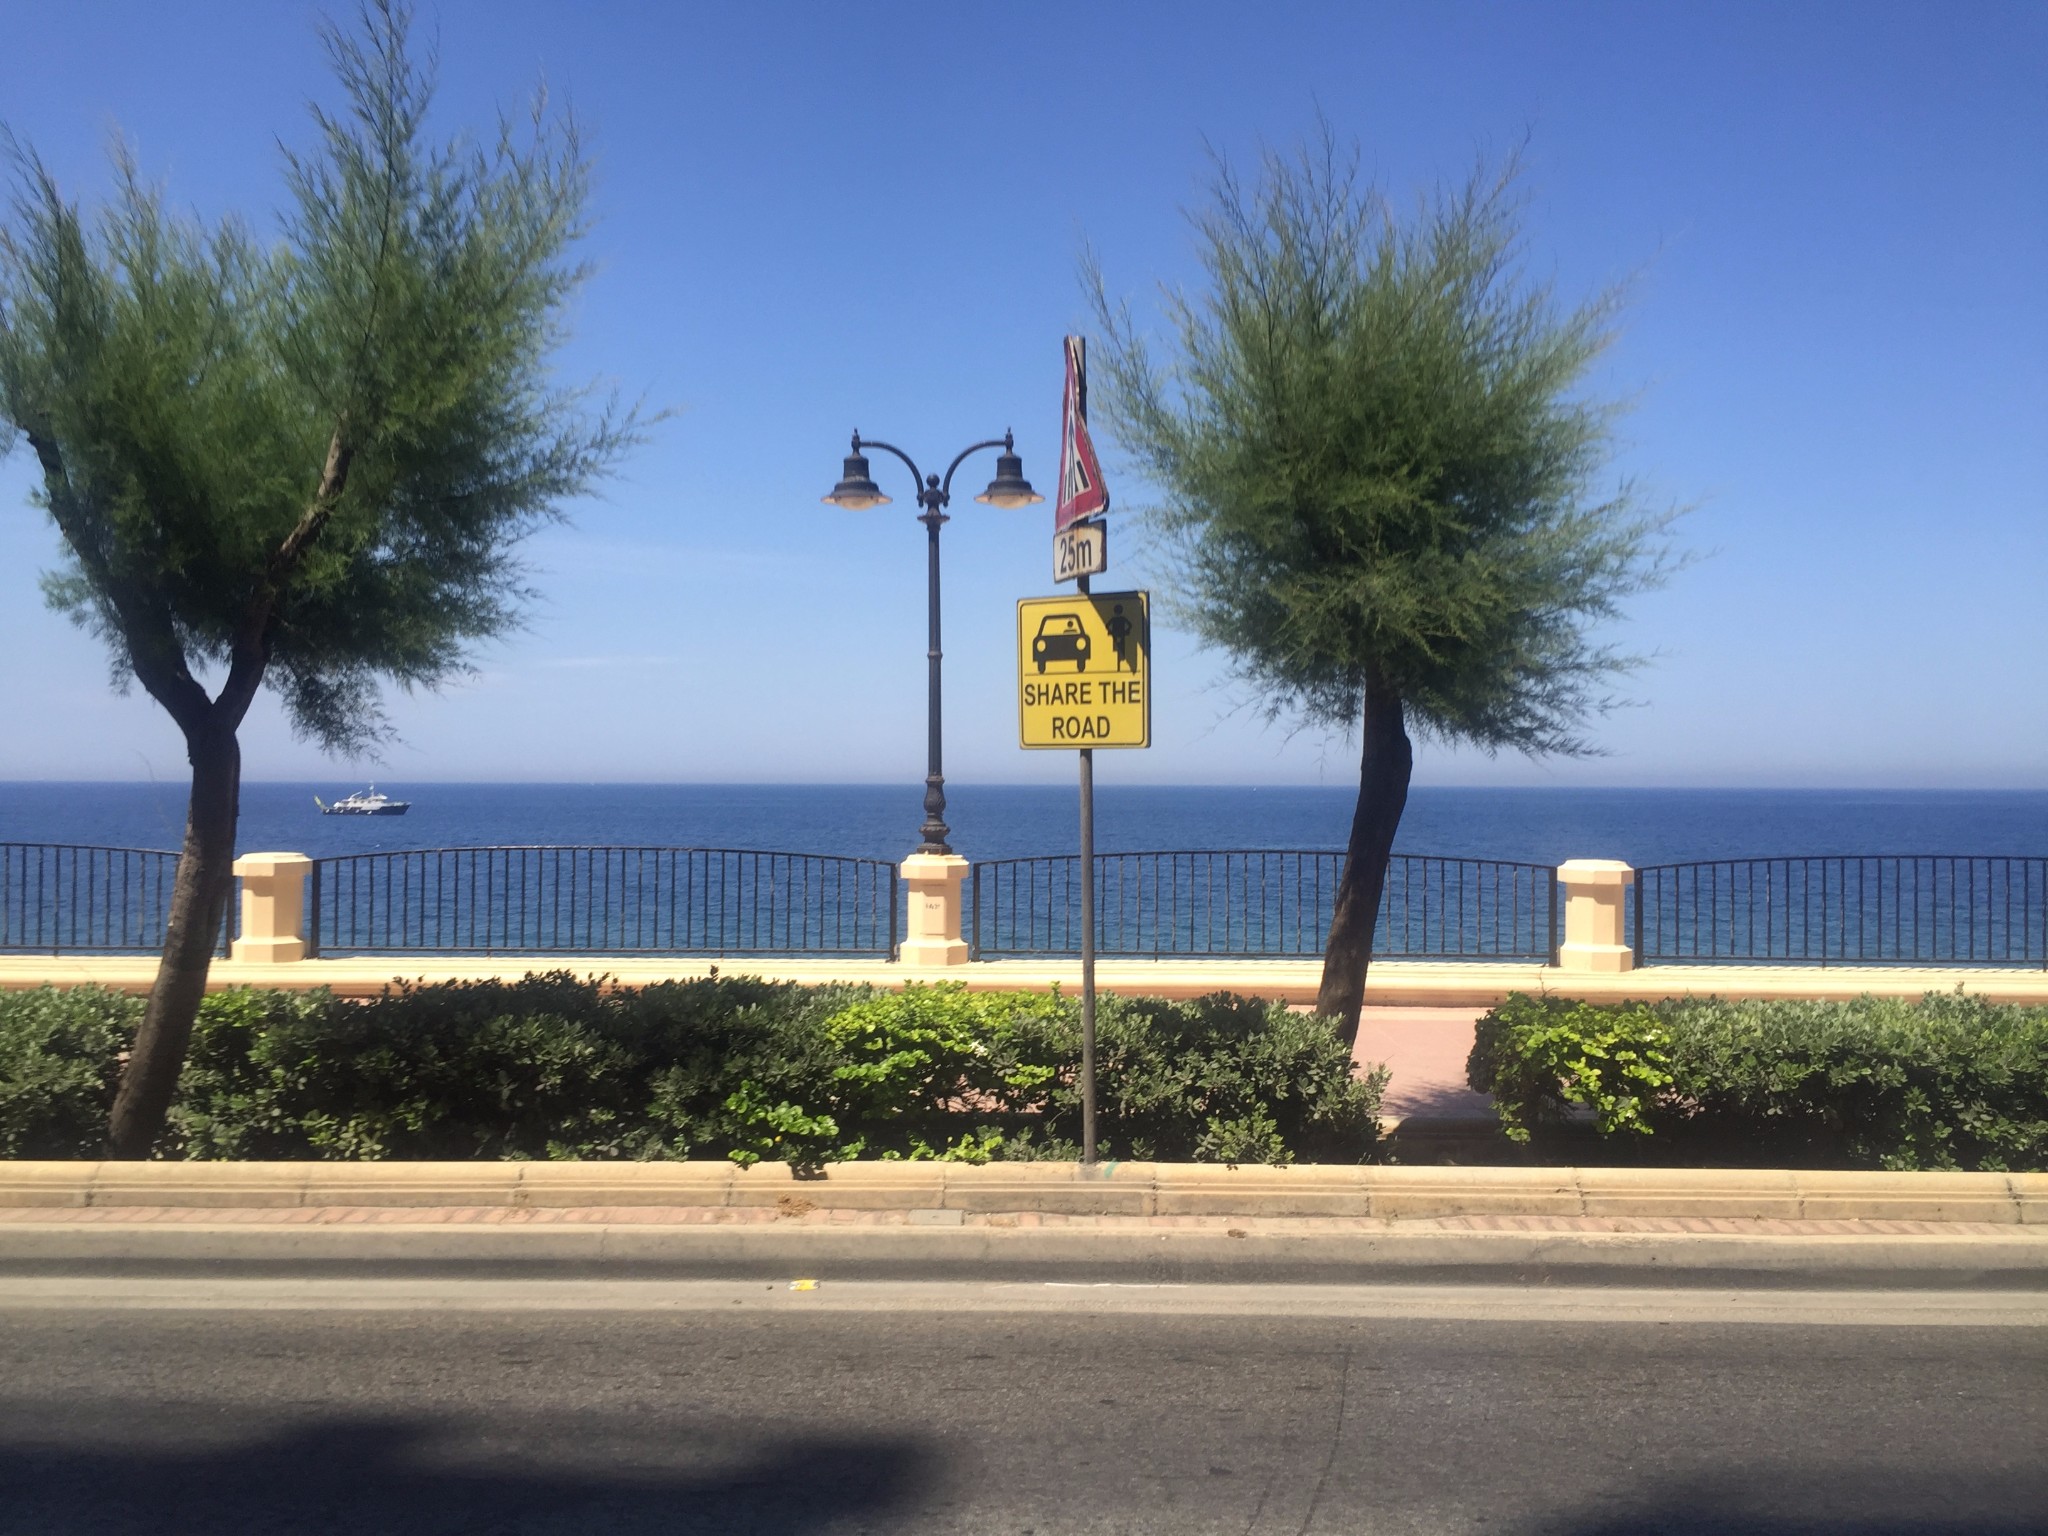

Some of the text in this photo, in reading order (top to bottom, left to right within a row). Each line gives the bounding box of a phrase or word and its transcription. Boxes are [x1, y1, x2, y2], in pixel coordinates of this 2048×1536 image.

[1060, 534, 1092, 574] 25m
[1024, 681, 1141, 706] SHARE THE
[1052, 715, 1111, 739] ROAD
